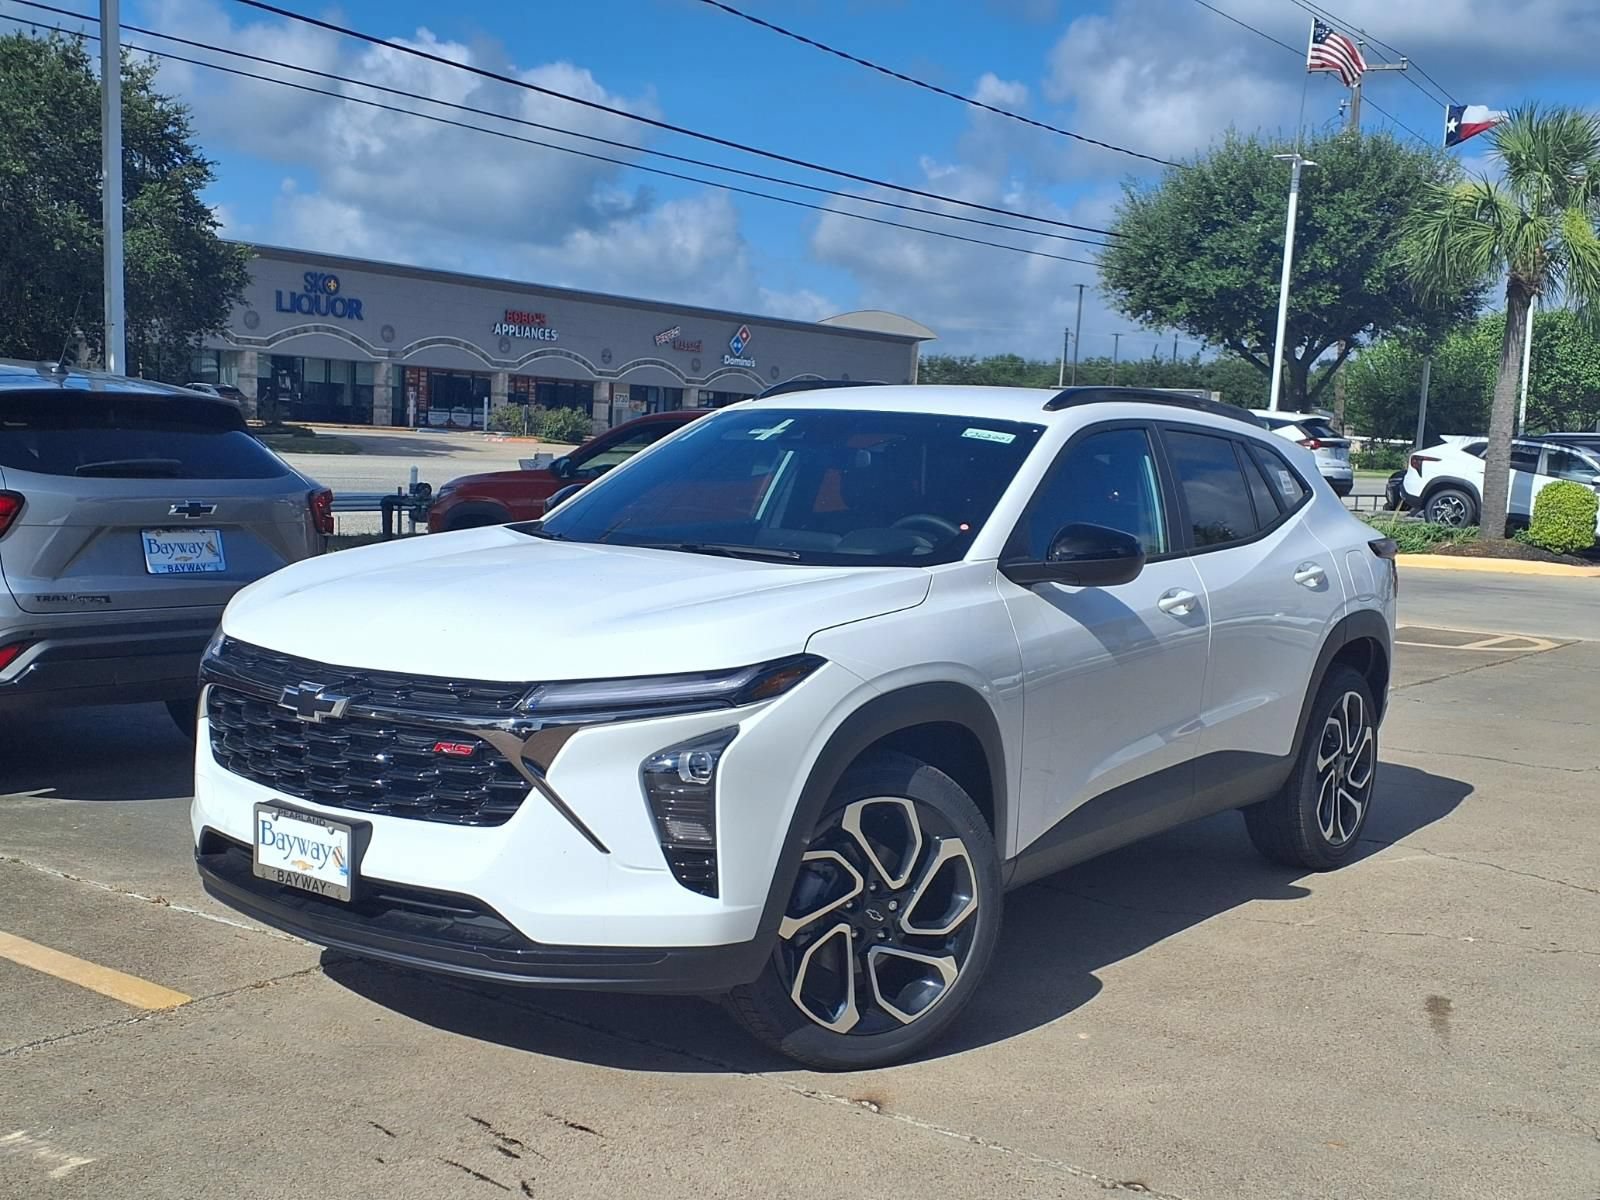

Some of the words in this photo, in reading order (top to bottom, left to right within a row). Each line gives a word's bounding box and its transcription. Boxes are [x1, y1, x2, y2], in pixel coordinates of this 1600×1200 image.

[304, 272, 340, 296] SKO
[276, 290, 364, 320] LIQUOR
[493, 323, 559, 341] APPLIANCES
[723, 355, 756, 368] Domino's
[147, 538, 206, 560] Bayway
[167, 563, 206, 573] BAYWAY
[433, 741, 475, 755] RS
[261, 820, 333, 870] Bayway
[277, 870, 327, 893] BAYWAY
